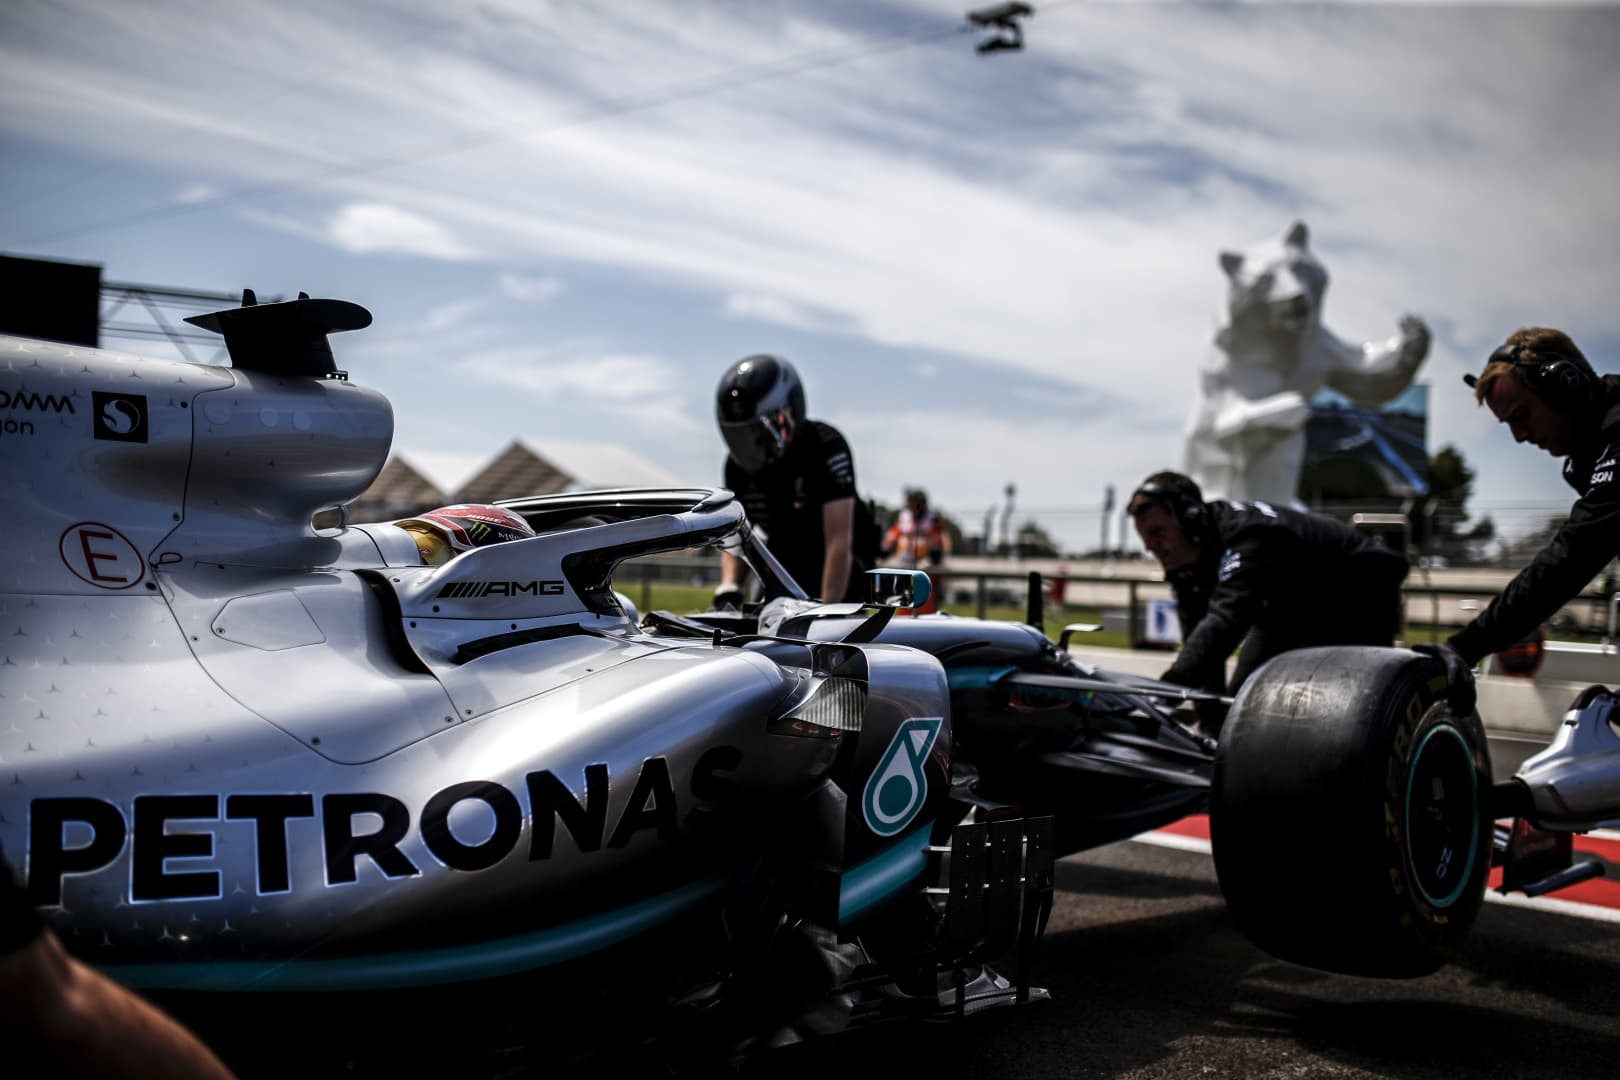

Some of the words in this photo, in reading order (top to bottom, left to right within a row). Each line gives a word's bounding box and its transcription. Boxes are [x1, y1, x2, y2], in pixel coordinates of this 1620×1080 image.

[78, 529, 128, 583] E
[480, 580, 565, 597] AMG
[28, 746, 743, 908] PETRONAS
